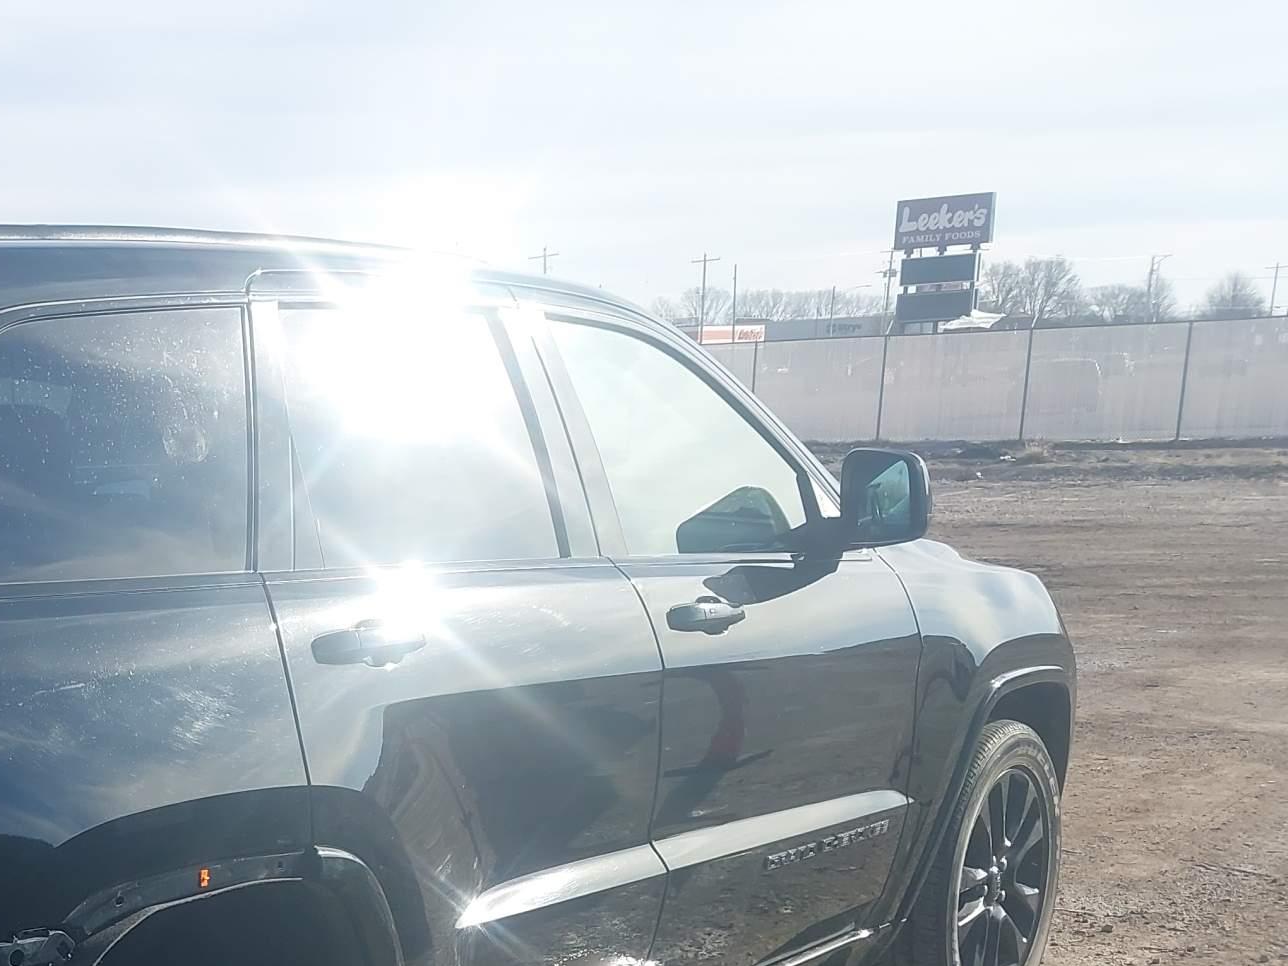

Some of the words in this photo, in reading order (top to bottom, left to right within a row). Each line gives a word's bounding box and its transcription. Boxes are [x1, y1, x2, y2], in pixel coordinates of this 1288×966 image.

[899, 203, 988, 233] Leeker's
[902, 233, 942, 244] FAMILY
[944, 230, 981, 241] FOODS
